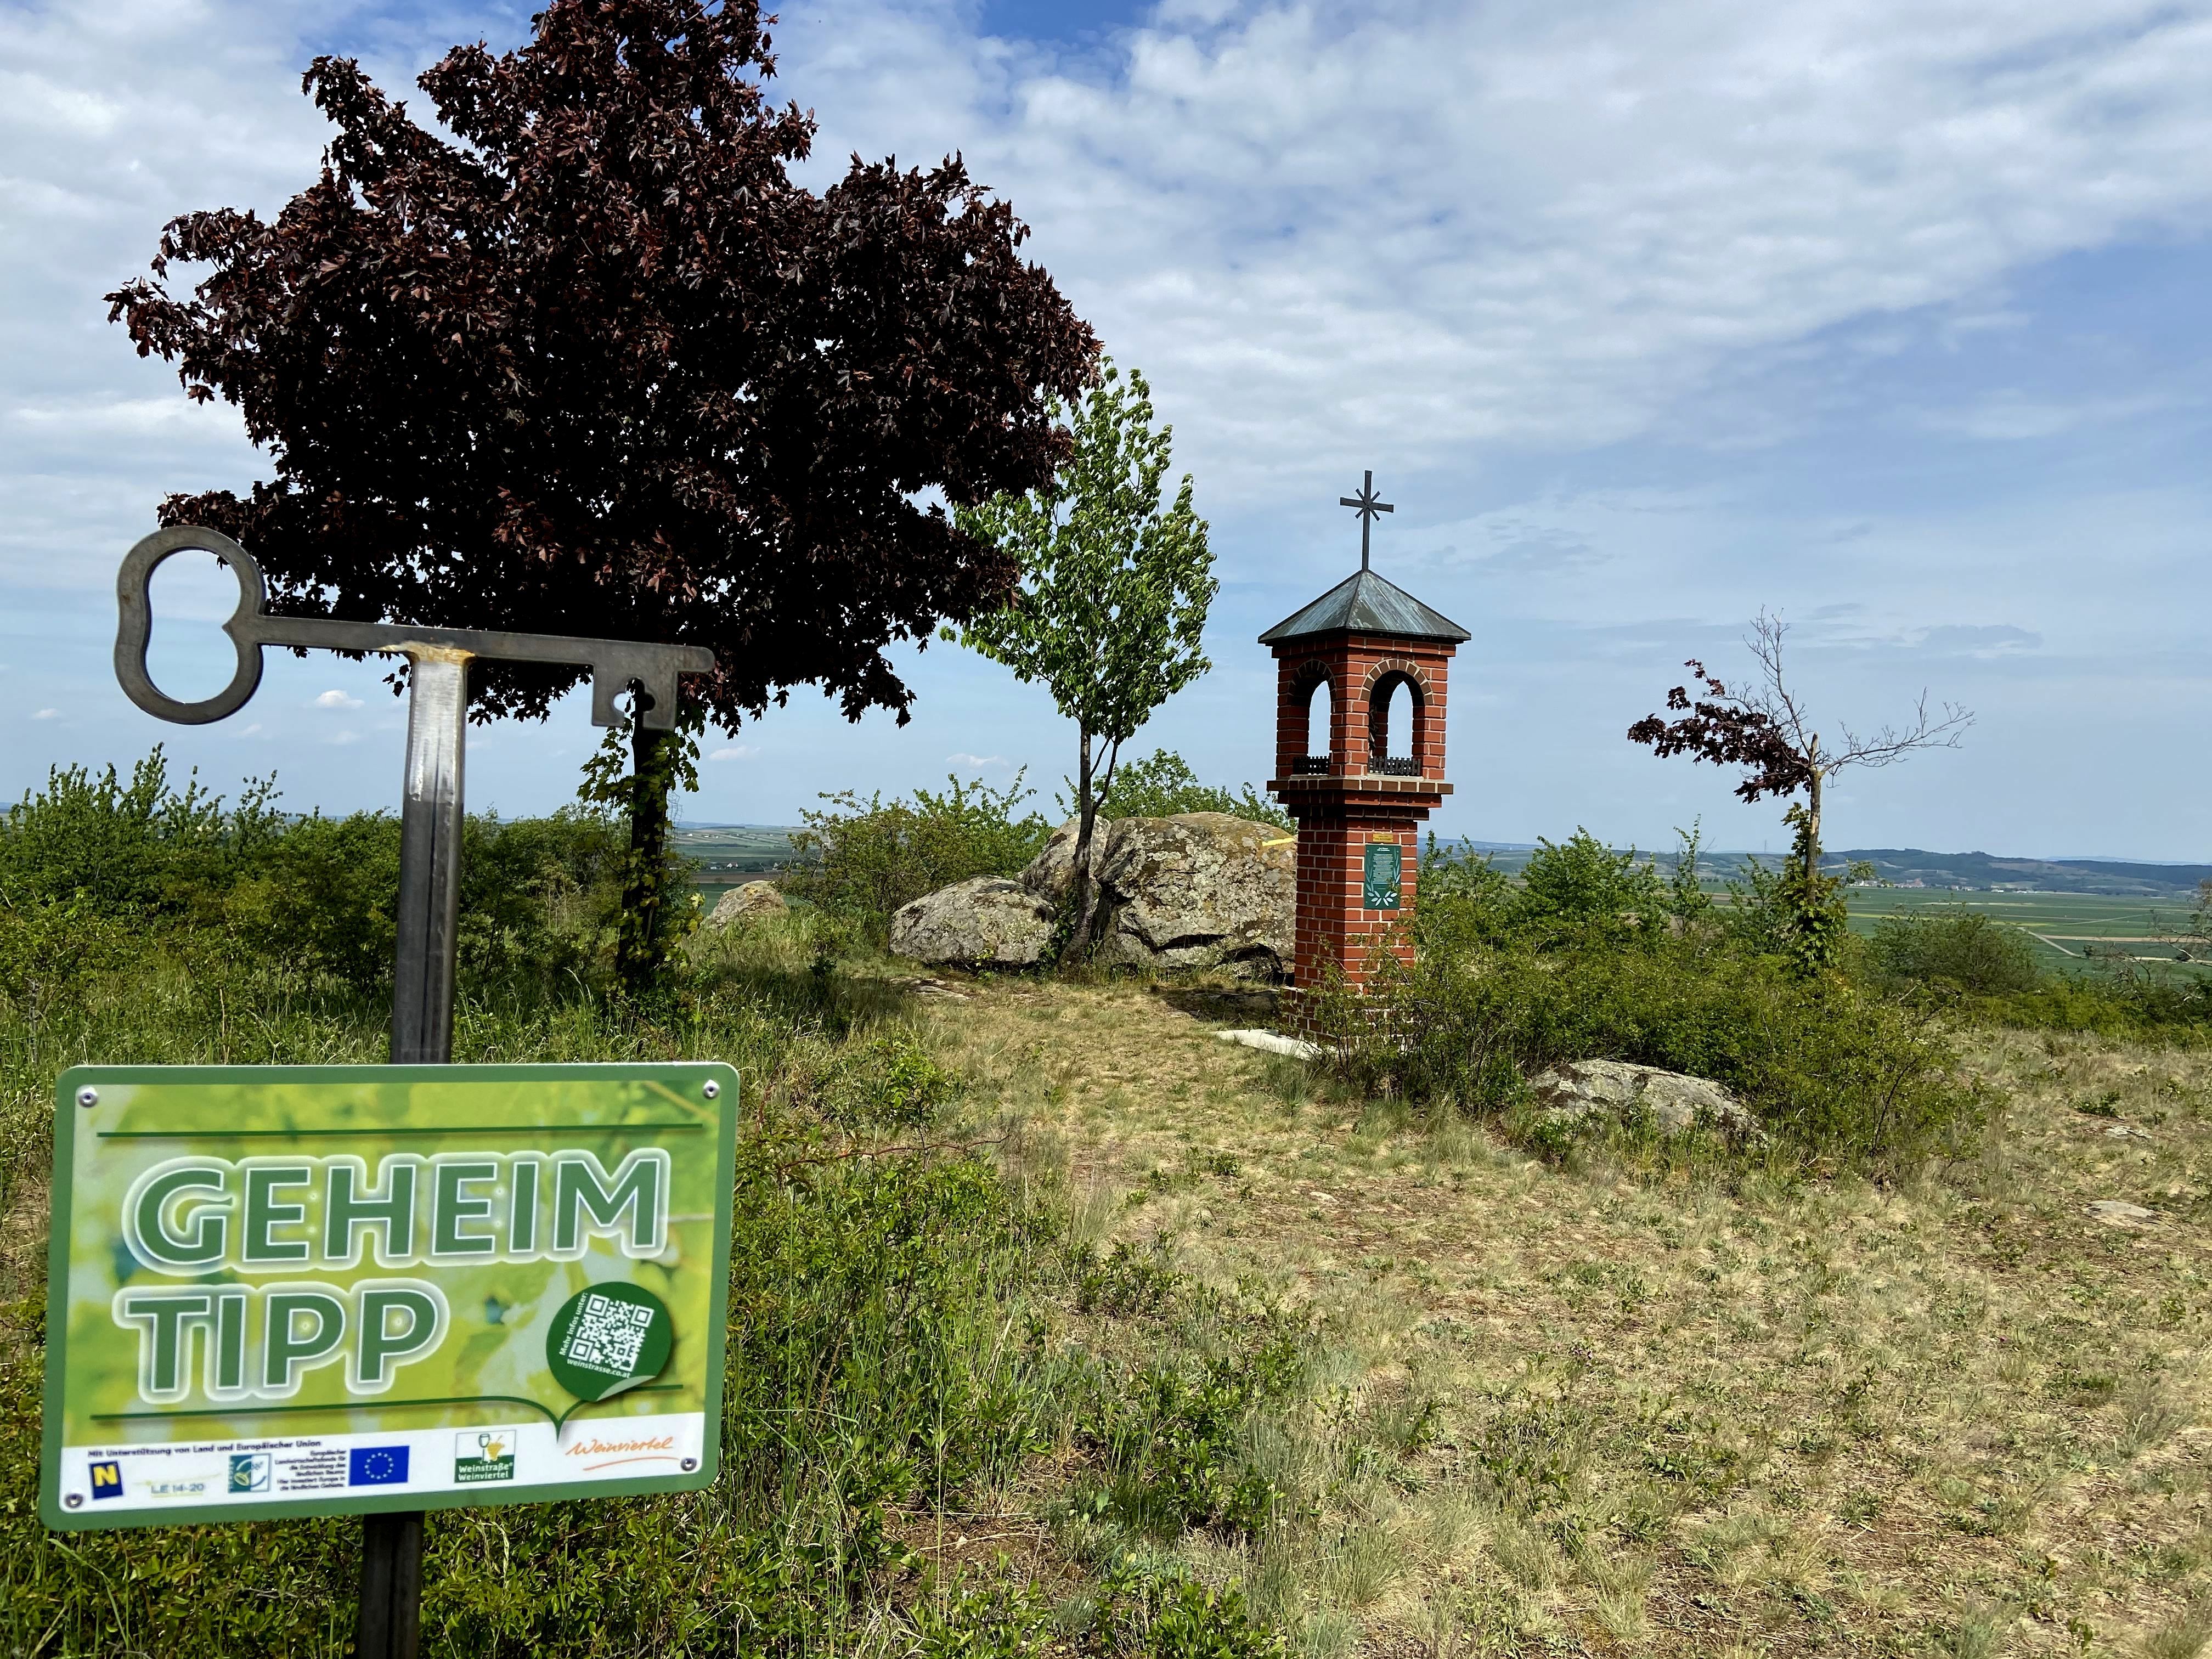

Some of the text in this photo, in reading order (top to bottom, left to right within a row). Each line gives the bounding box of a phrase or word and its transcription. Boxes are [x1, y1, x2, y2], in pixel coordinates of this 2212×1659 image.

[133, 1156, 663, 1266] GEHEIM
[559, 1293, 588, 1356] Mehr Infos unter:
[125, 1288, 437, 1393] TIPP
[567, 1359, 631, 1378] weinstrasse.co.at
[106, 1447, 171, 1457] Unterstützung
[236, 1441, 292, 1450] Europäischer
[566, 1436, 674, 1455] Weinviertel
[93, 1464, 117, 1487] N
[458, 1471, 509, 1481] Weinviertel
[151, 1483, 205, 1493] LE 14-20
